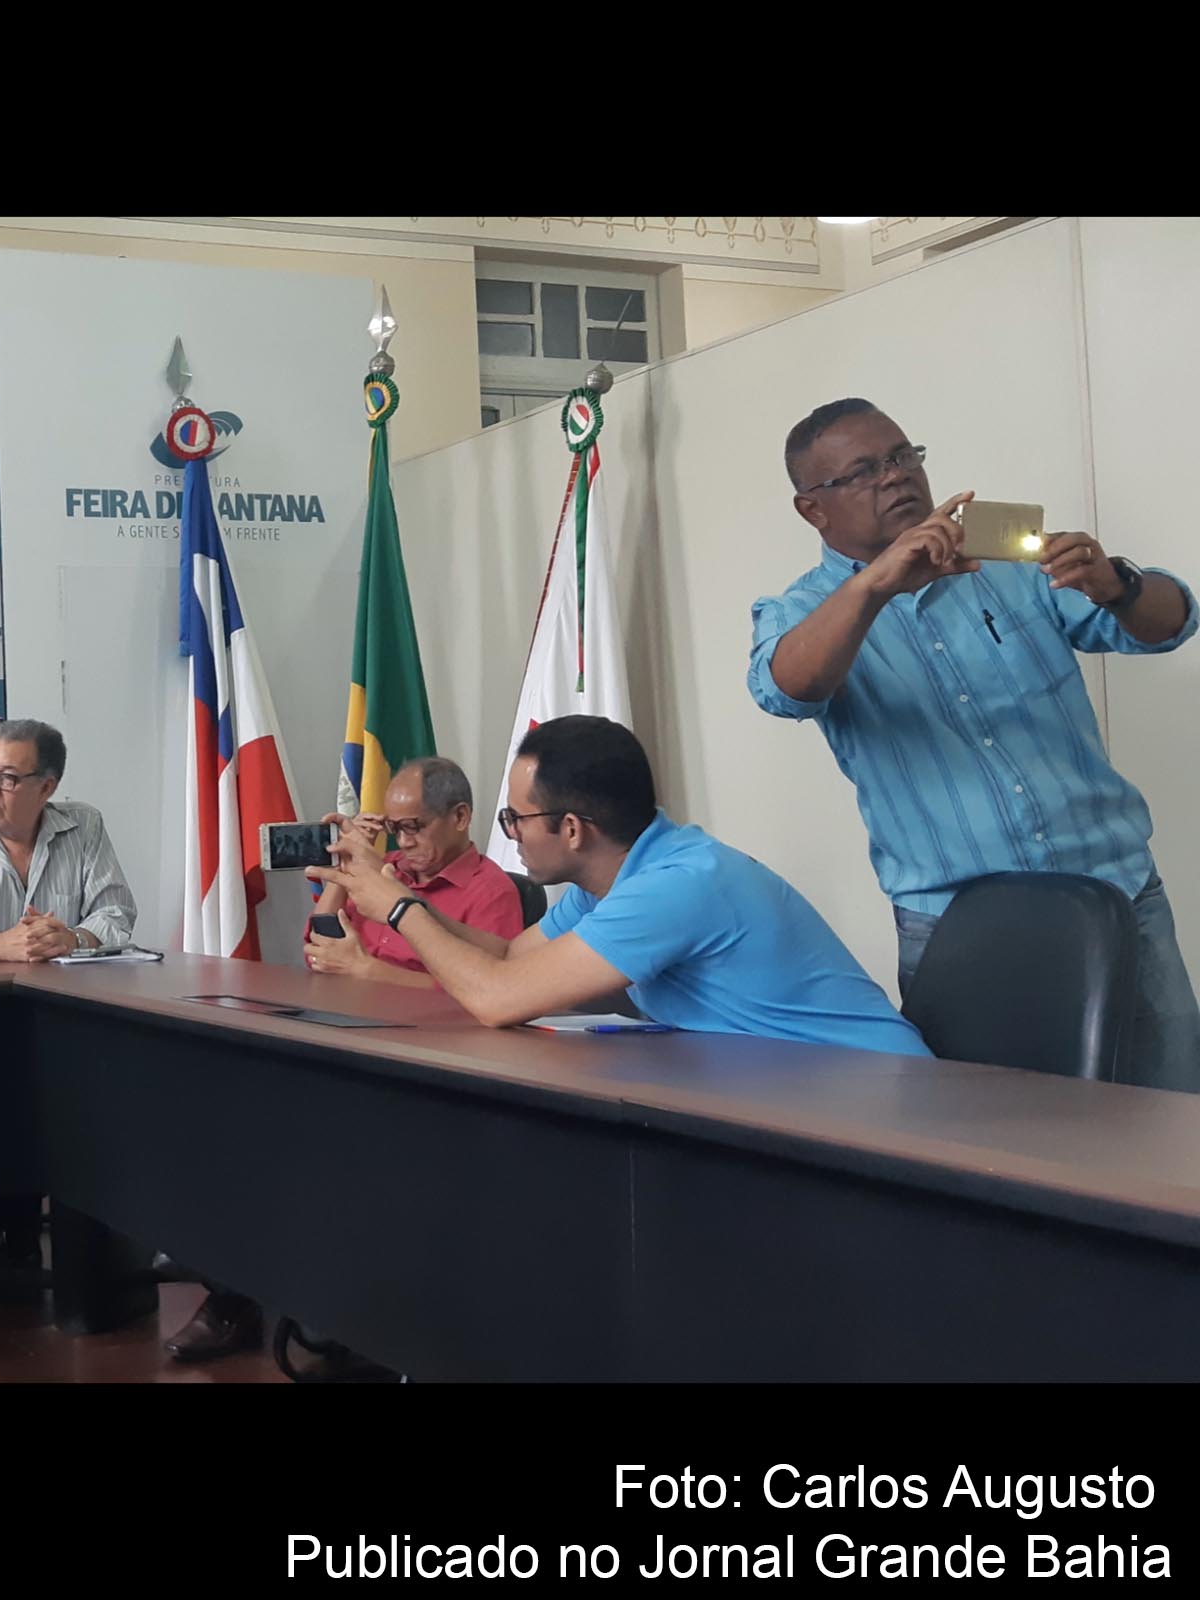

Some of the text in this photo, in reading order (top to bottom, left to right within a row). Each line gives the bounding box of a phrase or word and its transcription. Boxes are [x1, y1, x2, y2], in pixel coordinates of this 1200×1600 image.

[154, 475, 240, 487] PREURA
[65, 488, 151, 519] FEIRA
[218, 492, 325, 523] ANTANA
[117, 525, 125, 537] A
[129, 525, 168, 538] GENTE
[237, 527, 280, 541] FRENTE
